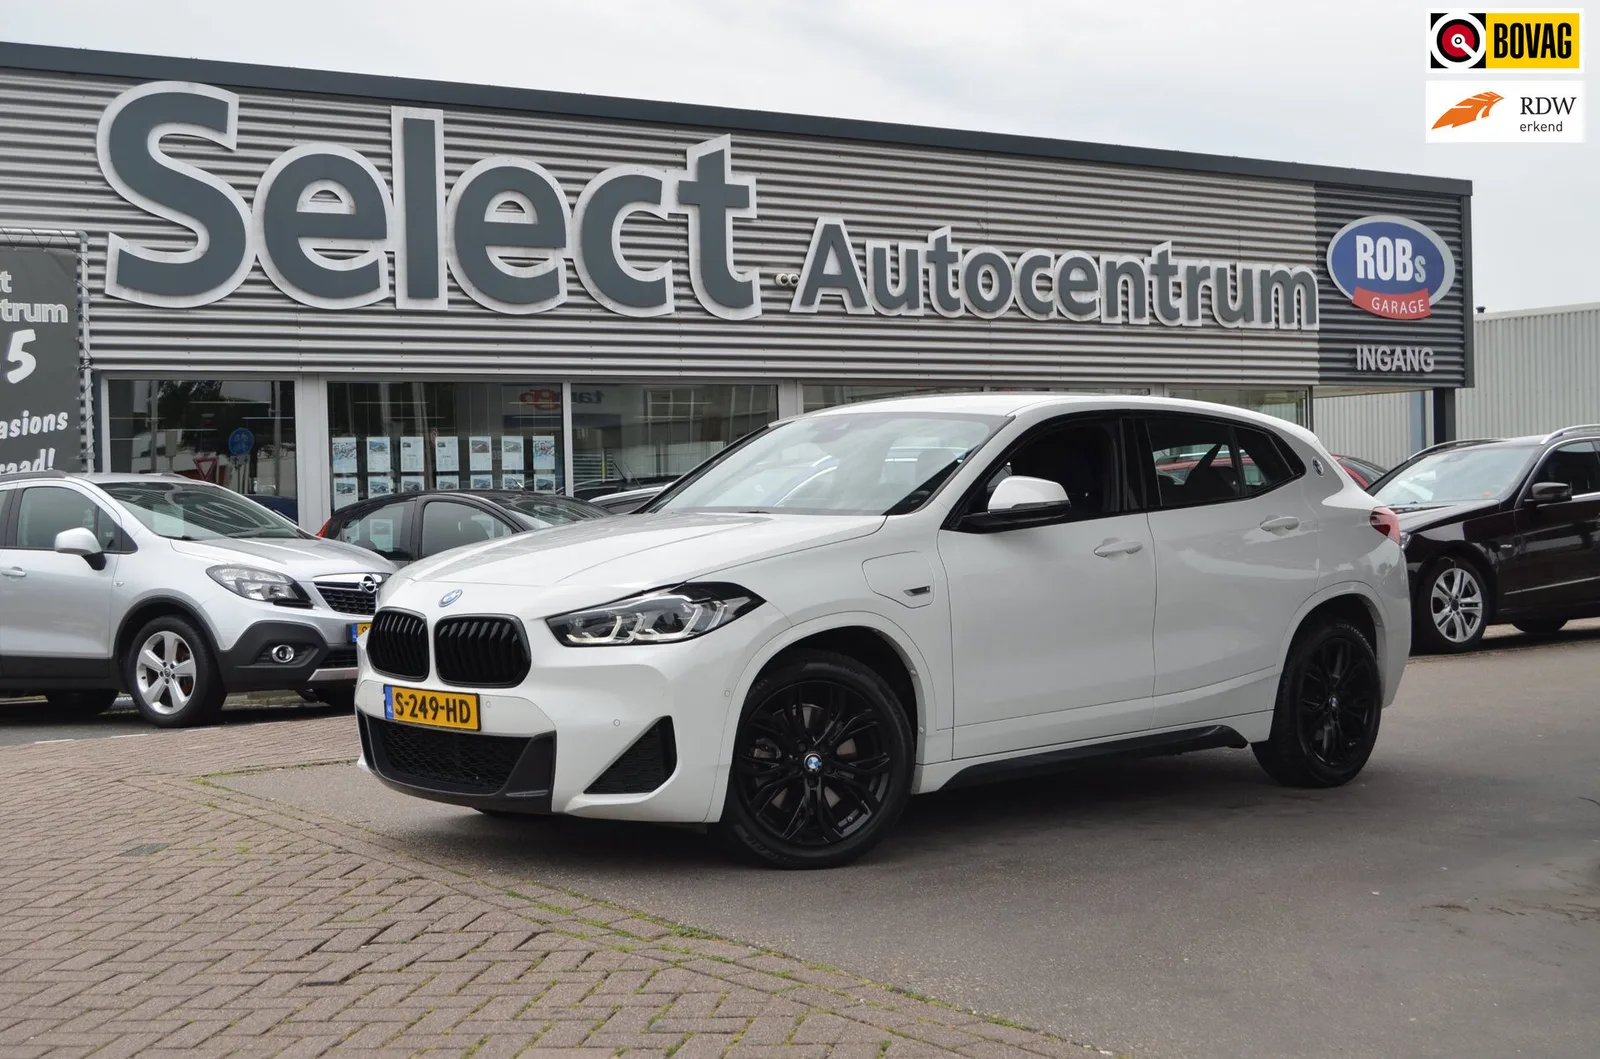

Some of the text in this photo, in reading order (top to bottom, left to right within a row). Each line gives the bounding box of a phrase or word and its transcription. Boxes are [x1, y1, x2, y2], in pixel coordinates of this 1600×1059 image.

[96, 80, 1320, 331] Select Autocentrum
[1355, 235, 1426, 283] ROBs
[0, 271, 12, 293] t
[1371, 297, 1425, 314] GARAGE
[1356, 344, 1435, 373] INGANG
[394, 691, 471, 723] S-249-HD
